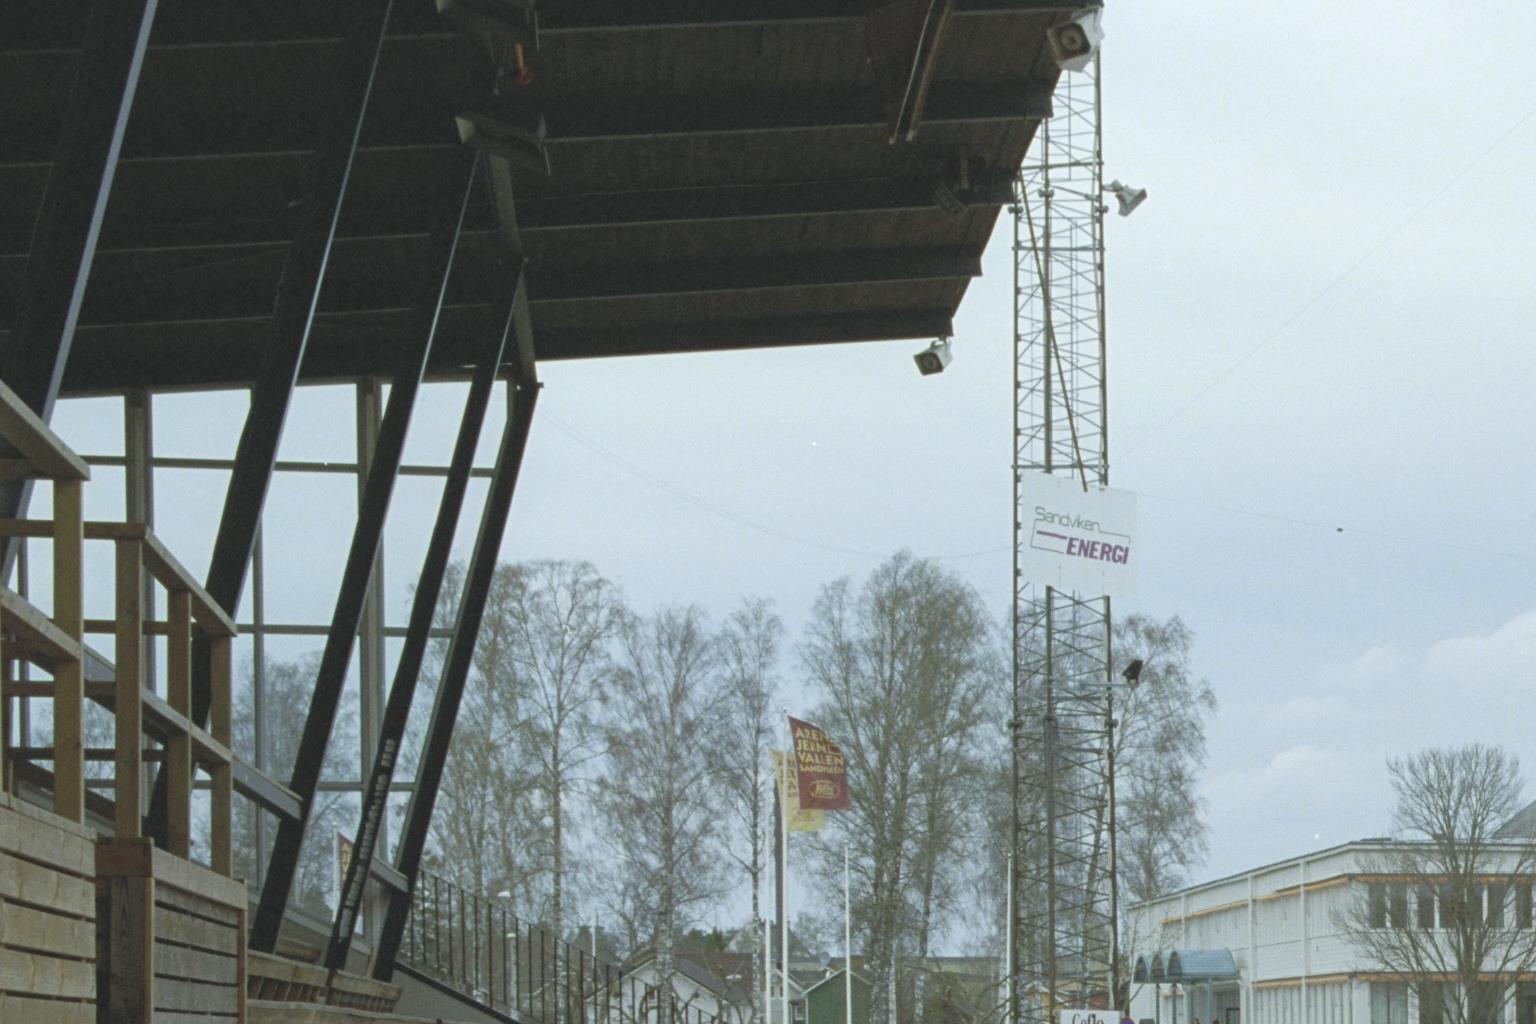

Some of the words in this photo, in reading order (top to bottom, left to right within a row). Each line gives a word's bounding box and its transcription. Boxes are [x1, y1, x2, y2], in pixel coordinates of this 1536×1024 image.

[1034, 506, 1100, 531] Sandviken
[1066, 537, 1129, 565] ENERGI
[798, 751, 844, 766] VALLEN
